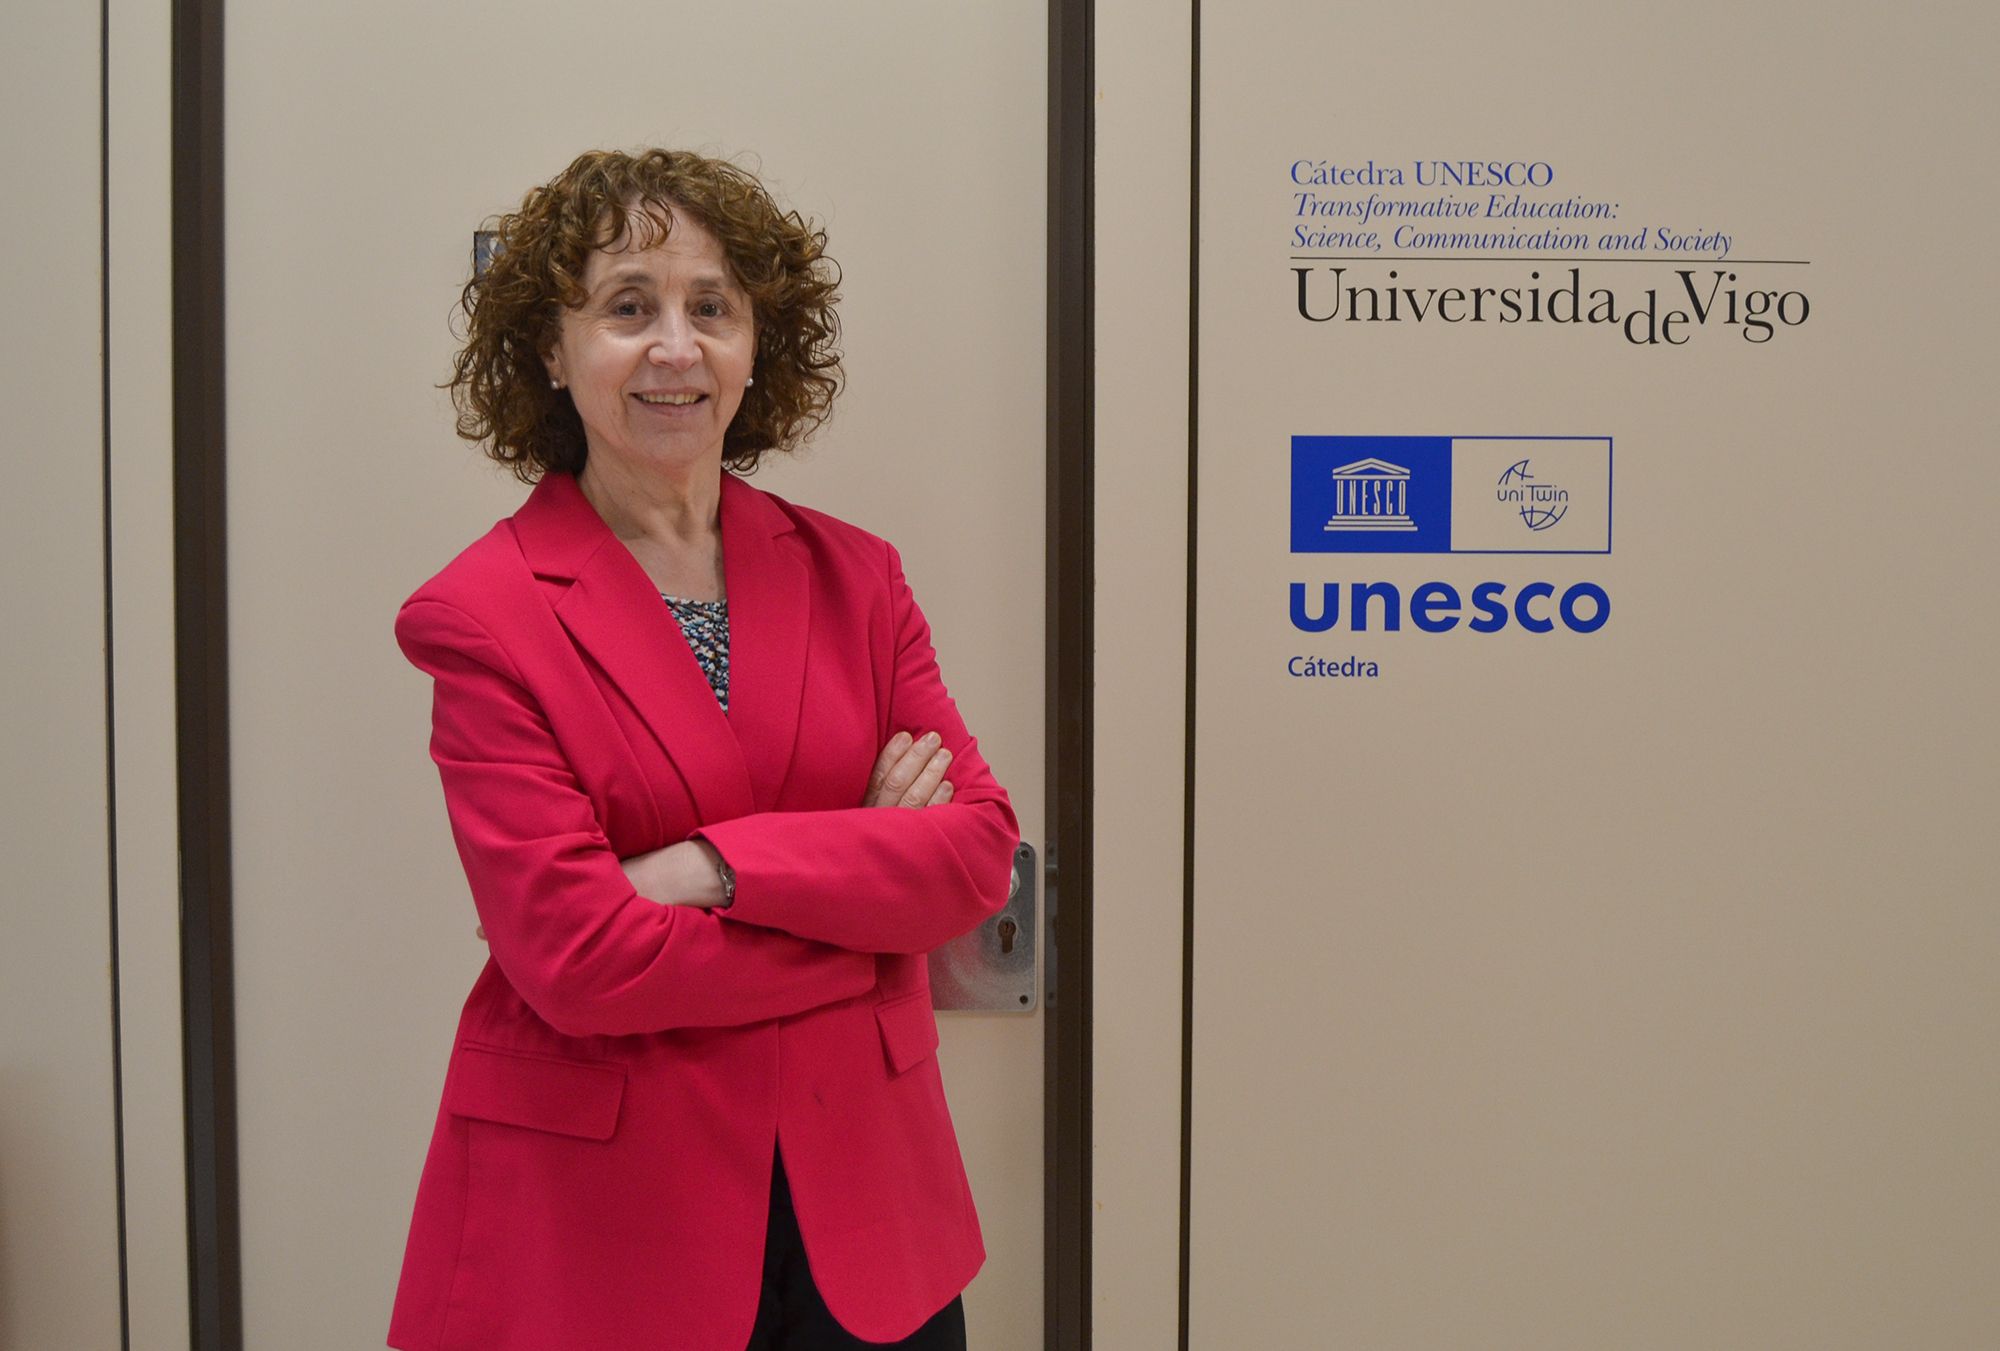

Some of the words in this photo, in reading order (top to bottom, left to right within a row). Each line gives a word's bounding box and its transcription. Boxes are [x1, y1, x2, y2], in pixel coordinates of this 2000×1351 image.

[1290, 160, 1404, 186] Cátedra
[1415, 161, 1554, 187] UNESCO
[1294, 193, 1479, 225] Transformative
[1485, 194, 1620, 219] Education:
[1291, 225, 1382, 252] Science,
[1394, 226, 1589, 250] Communication
[1598, 227, 1647, 251] and
[1654, 228, 1733, 259] Society
[1336, 480, 1406, 516] UNESCO
[1290, 582, 1611, 633] unesco
[1287, 656, 1379, 678] Cátedra
